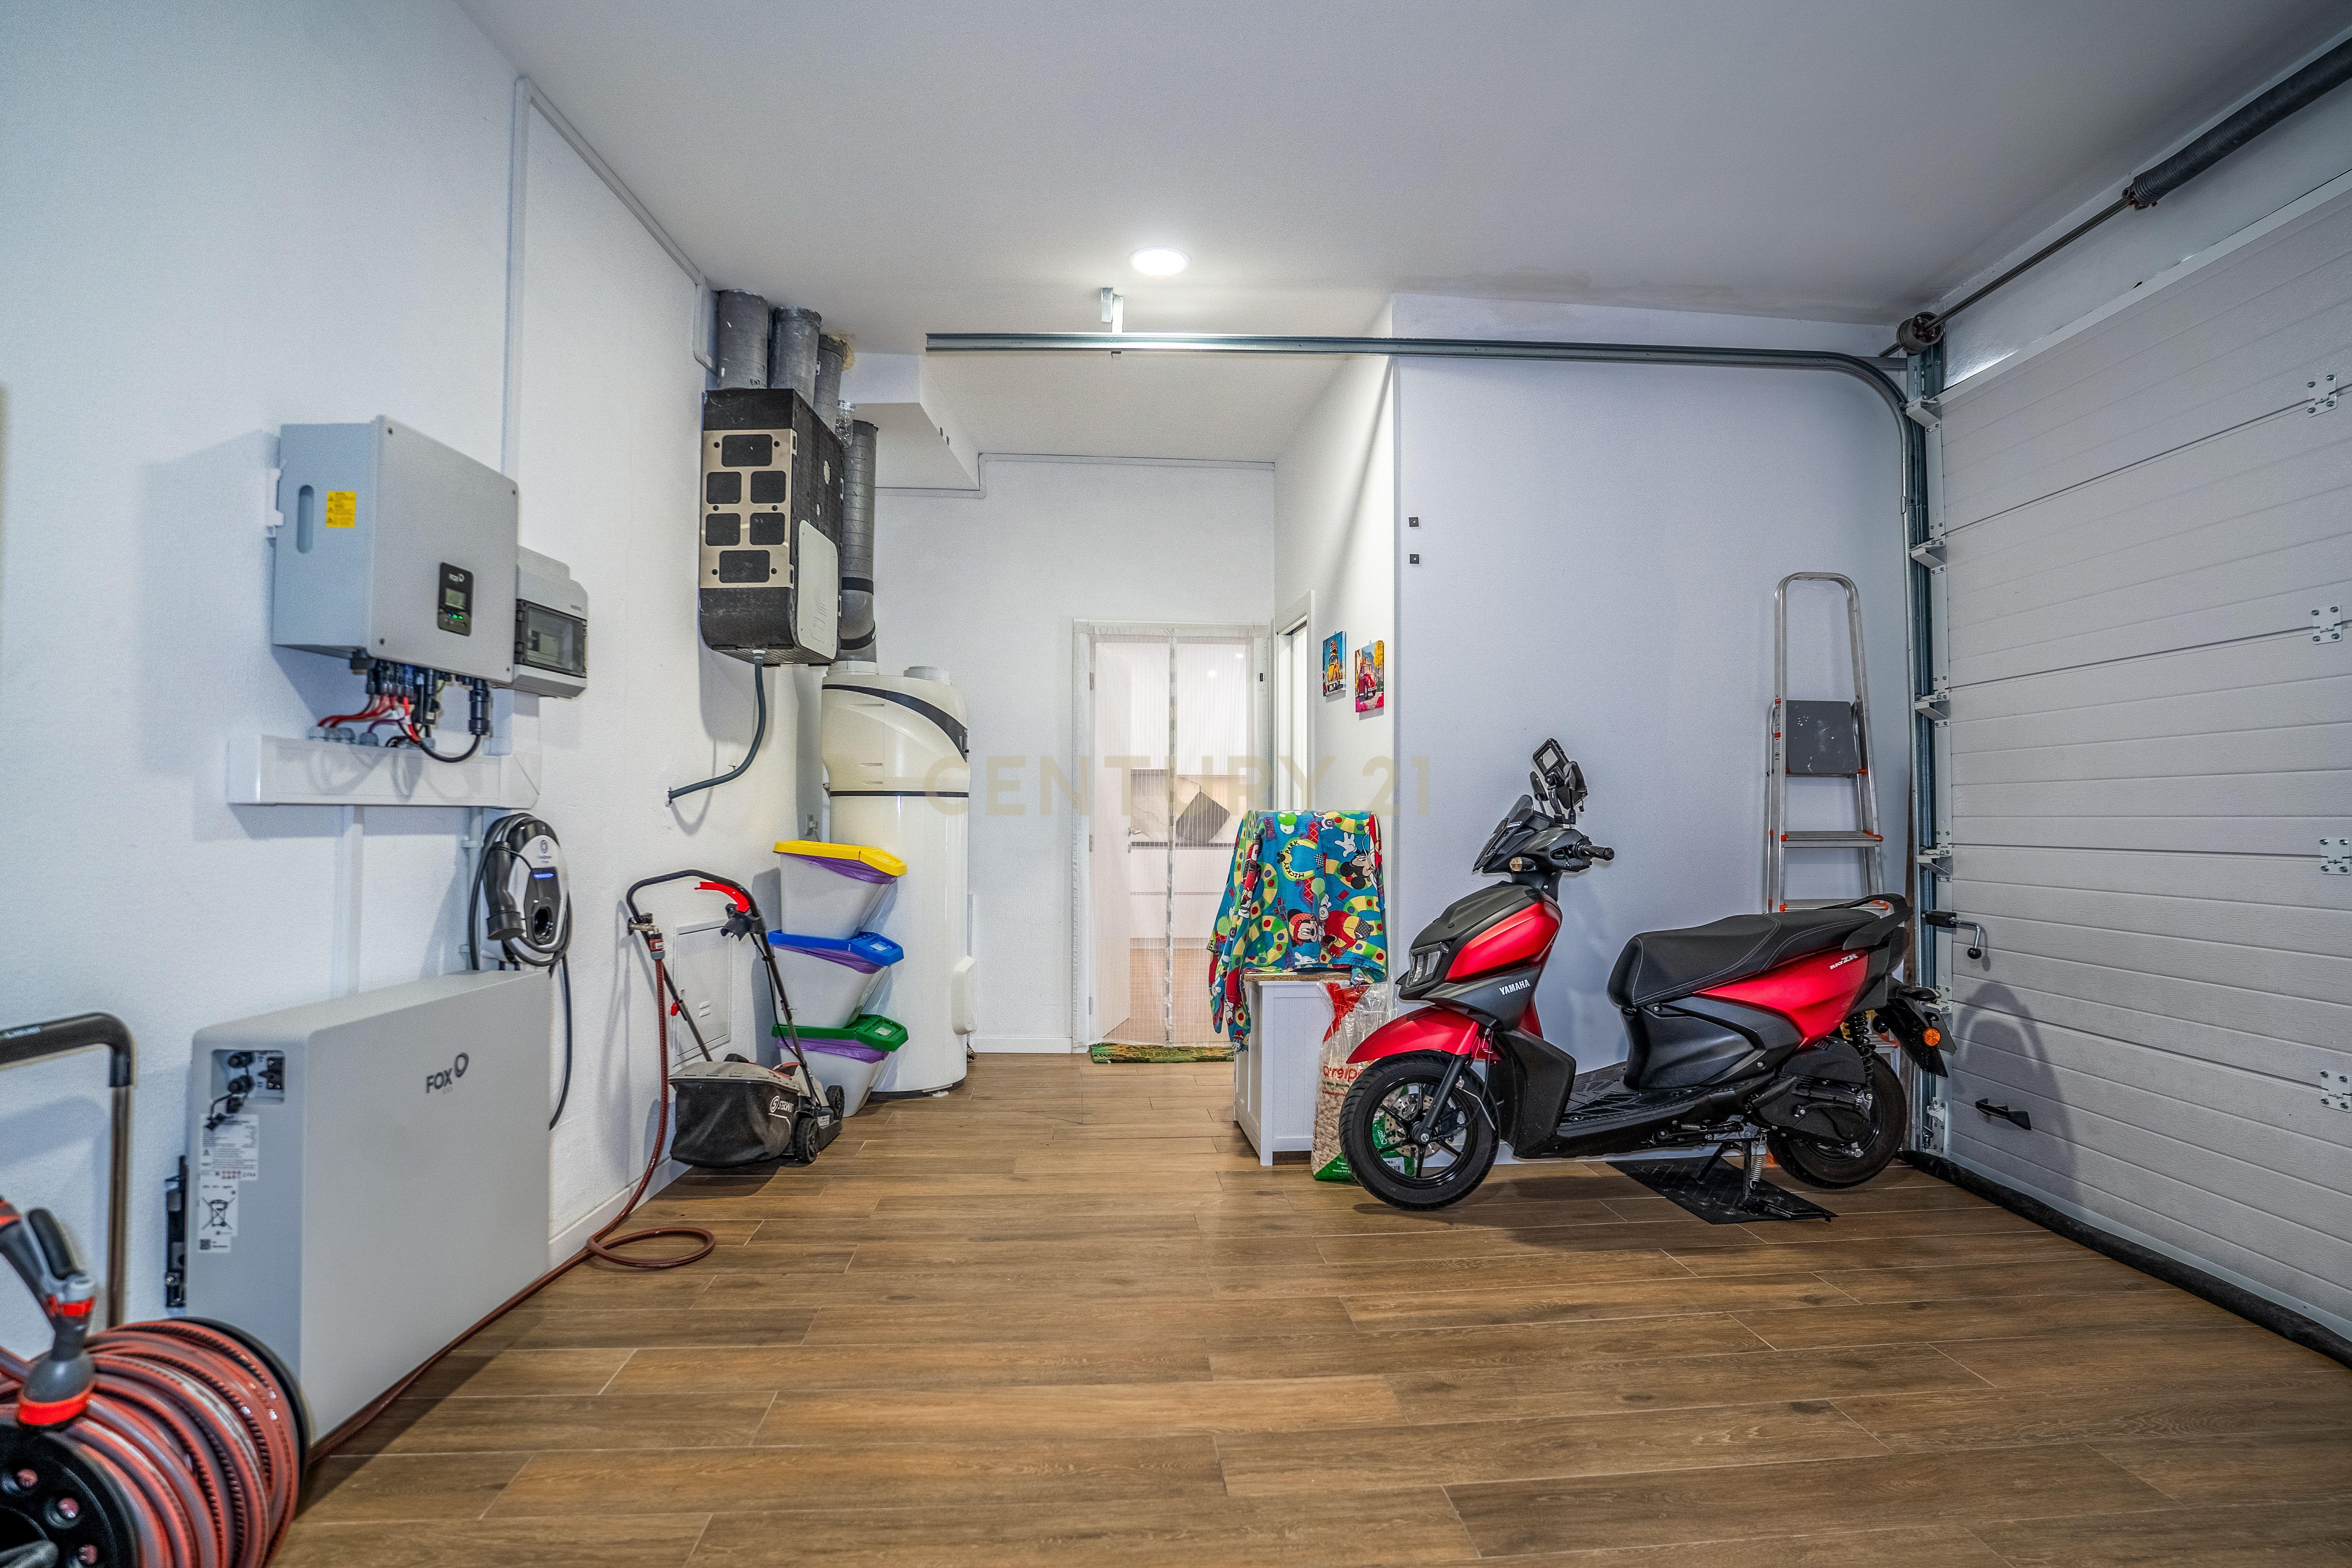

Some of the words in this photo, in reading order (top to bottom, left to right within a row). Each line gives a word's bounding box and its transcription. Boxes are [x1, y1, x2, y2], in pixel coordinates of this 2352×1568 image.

[1284, 840, 1300, 854] PARK
[1283, 861, 1304, 878] MICKEY
[1498, 979, 1531, 995] YAMAHA
